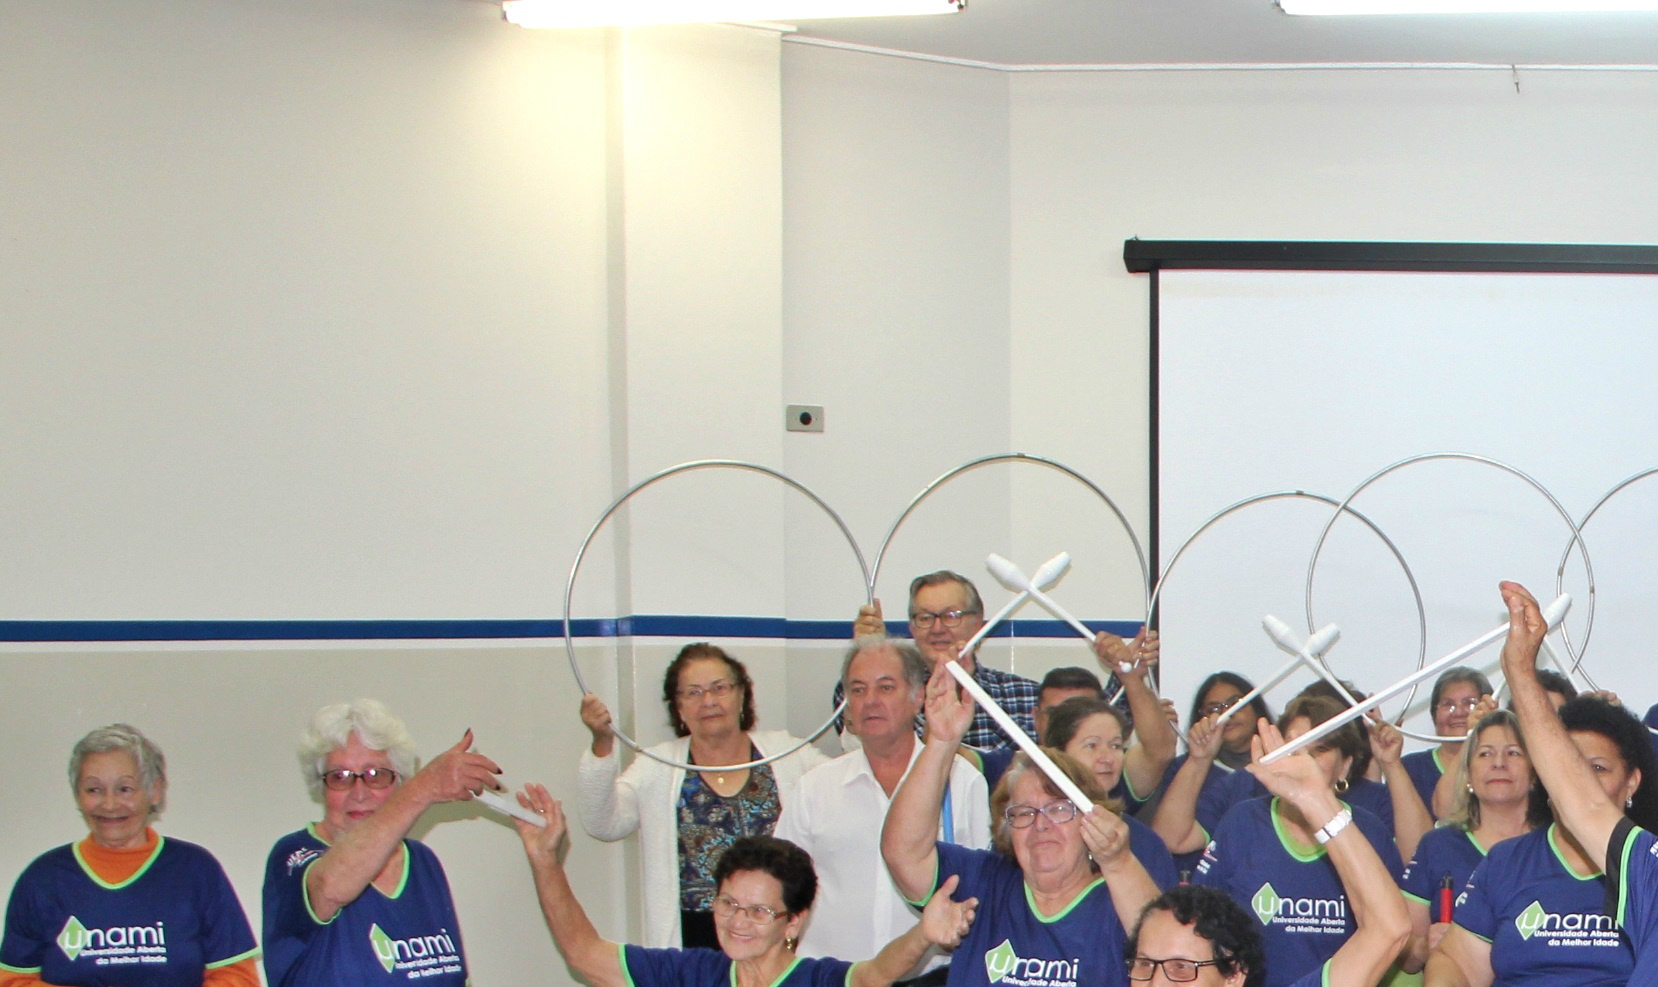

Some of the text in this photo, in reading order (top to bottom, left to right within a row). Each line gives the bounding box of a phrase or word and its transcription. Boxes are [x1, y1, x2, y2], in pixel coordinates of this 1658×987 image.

[1272, 916, 1346, 926] Universidade Aberta
[1285, 925, 1345, 934] da Melhor Idade
[1534, 929, 1589, 938] Universidade
[1548, 937, 1620, 947] da Melhor Idade
[1049, 979, 1077, 987] Aberta
